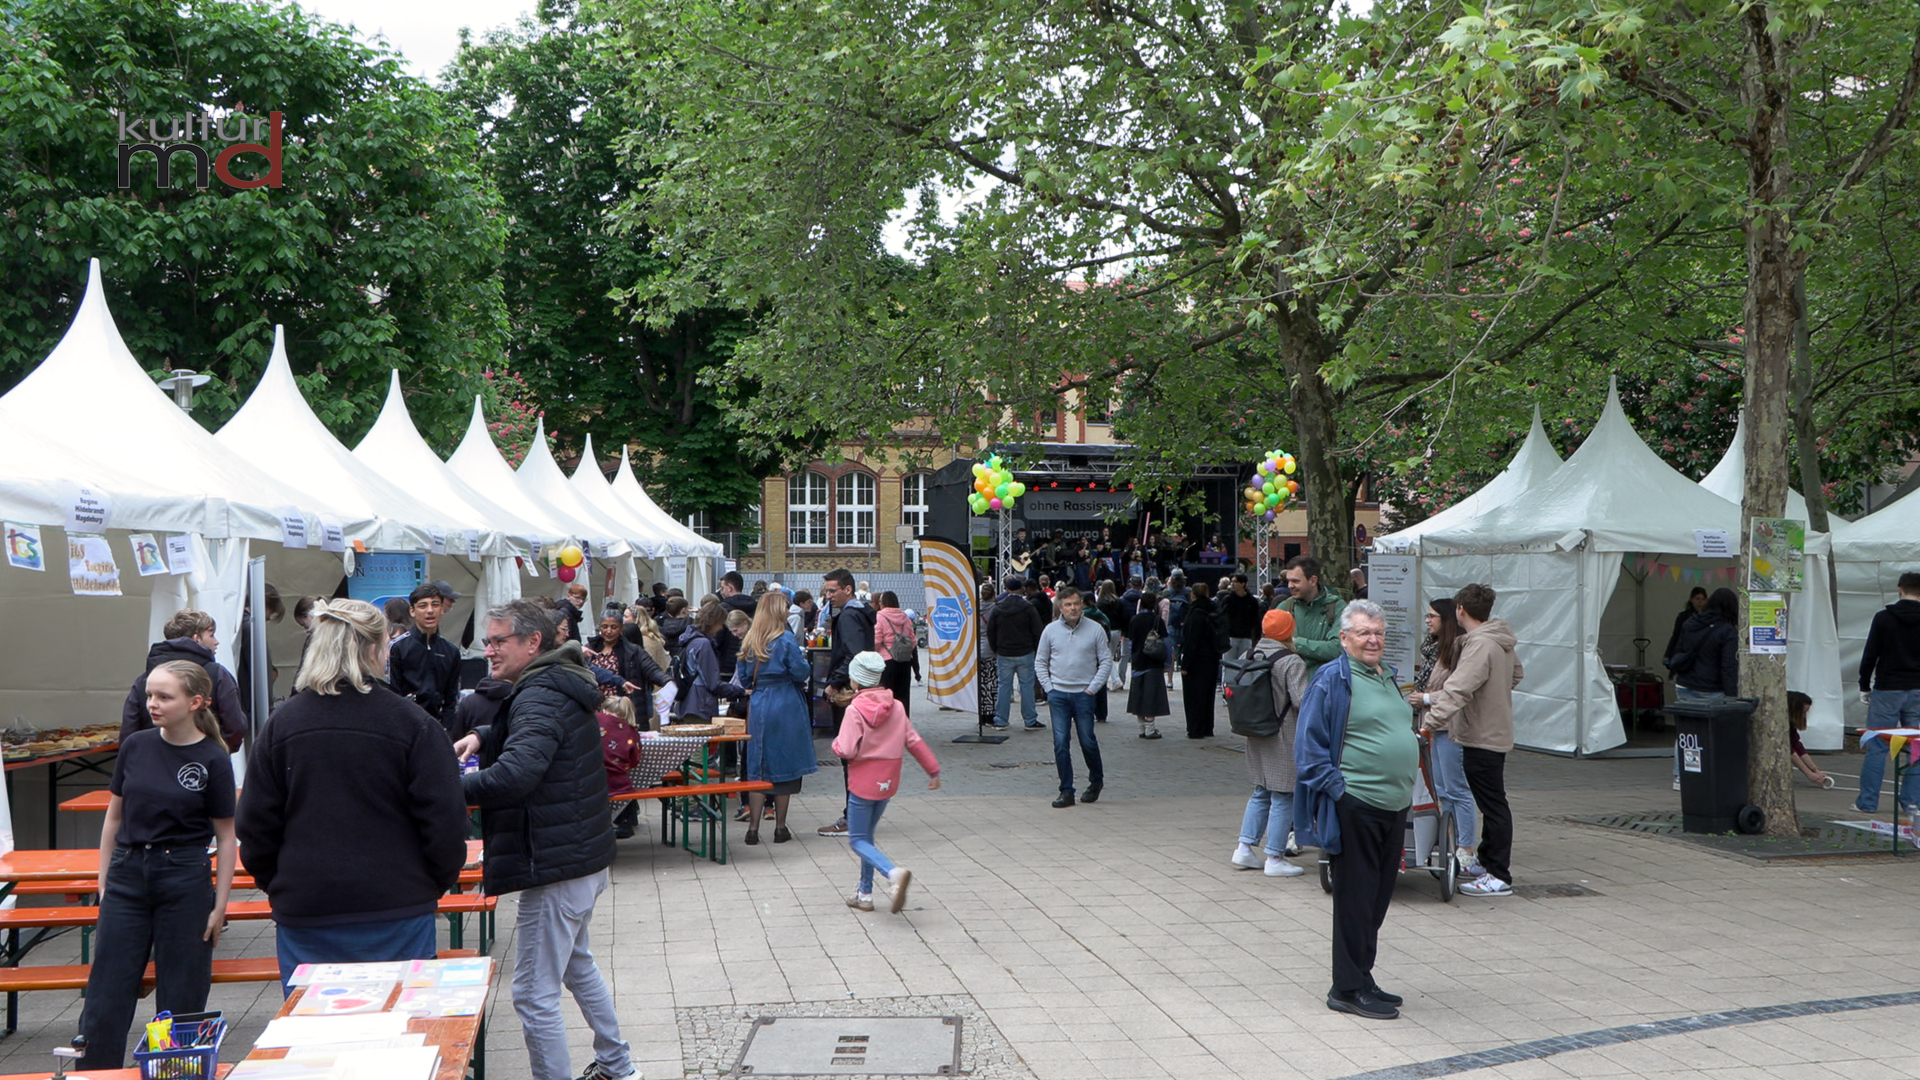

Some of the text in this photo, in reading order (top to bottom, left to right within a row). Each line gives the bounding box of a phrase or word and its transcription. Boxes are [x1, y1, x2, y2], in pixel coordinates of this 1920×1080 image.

[75, 505, 105, 515] Hildebrandt
[1030, 501, 1060, 511] ohne
[75, 514, 103, 524] Magdeburg
[1031, 528, 1051, 539] mit
[1679, 733, 1703, 750] 80L
